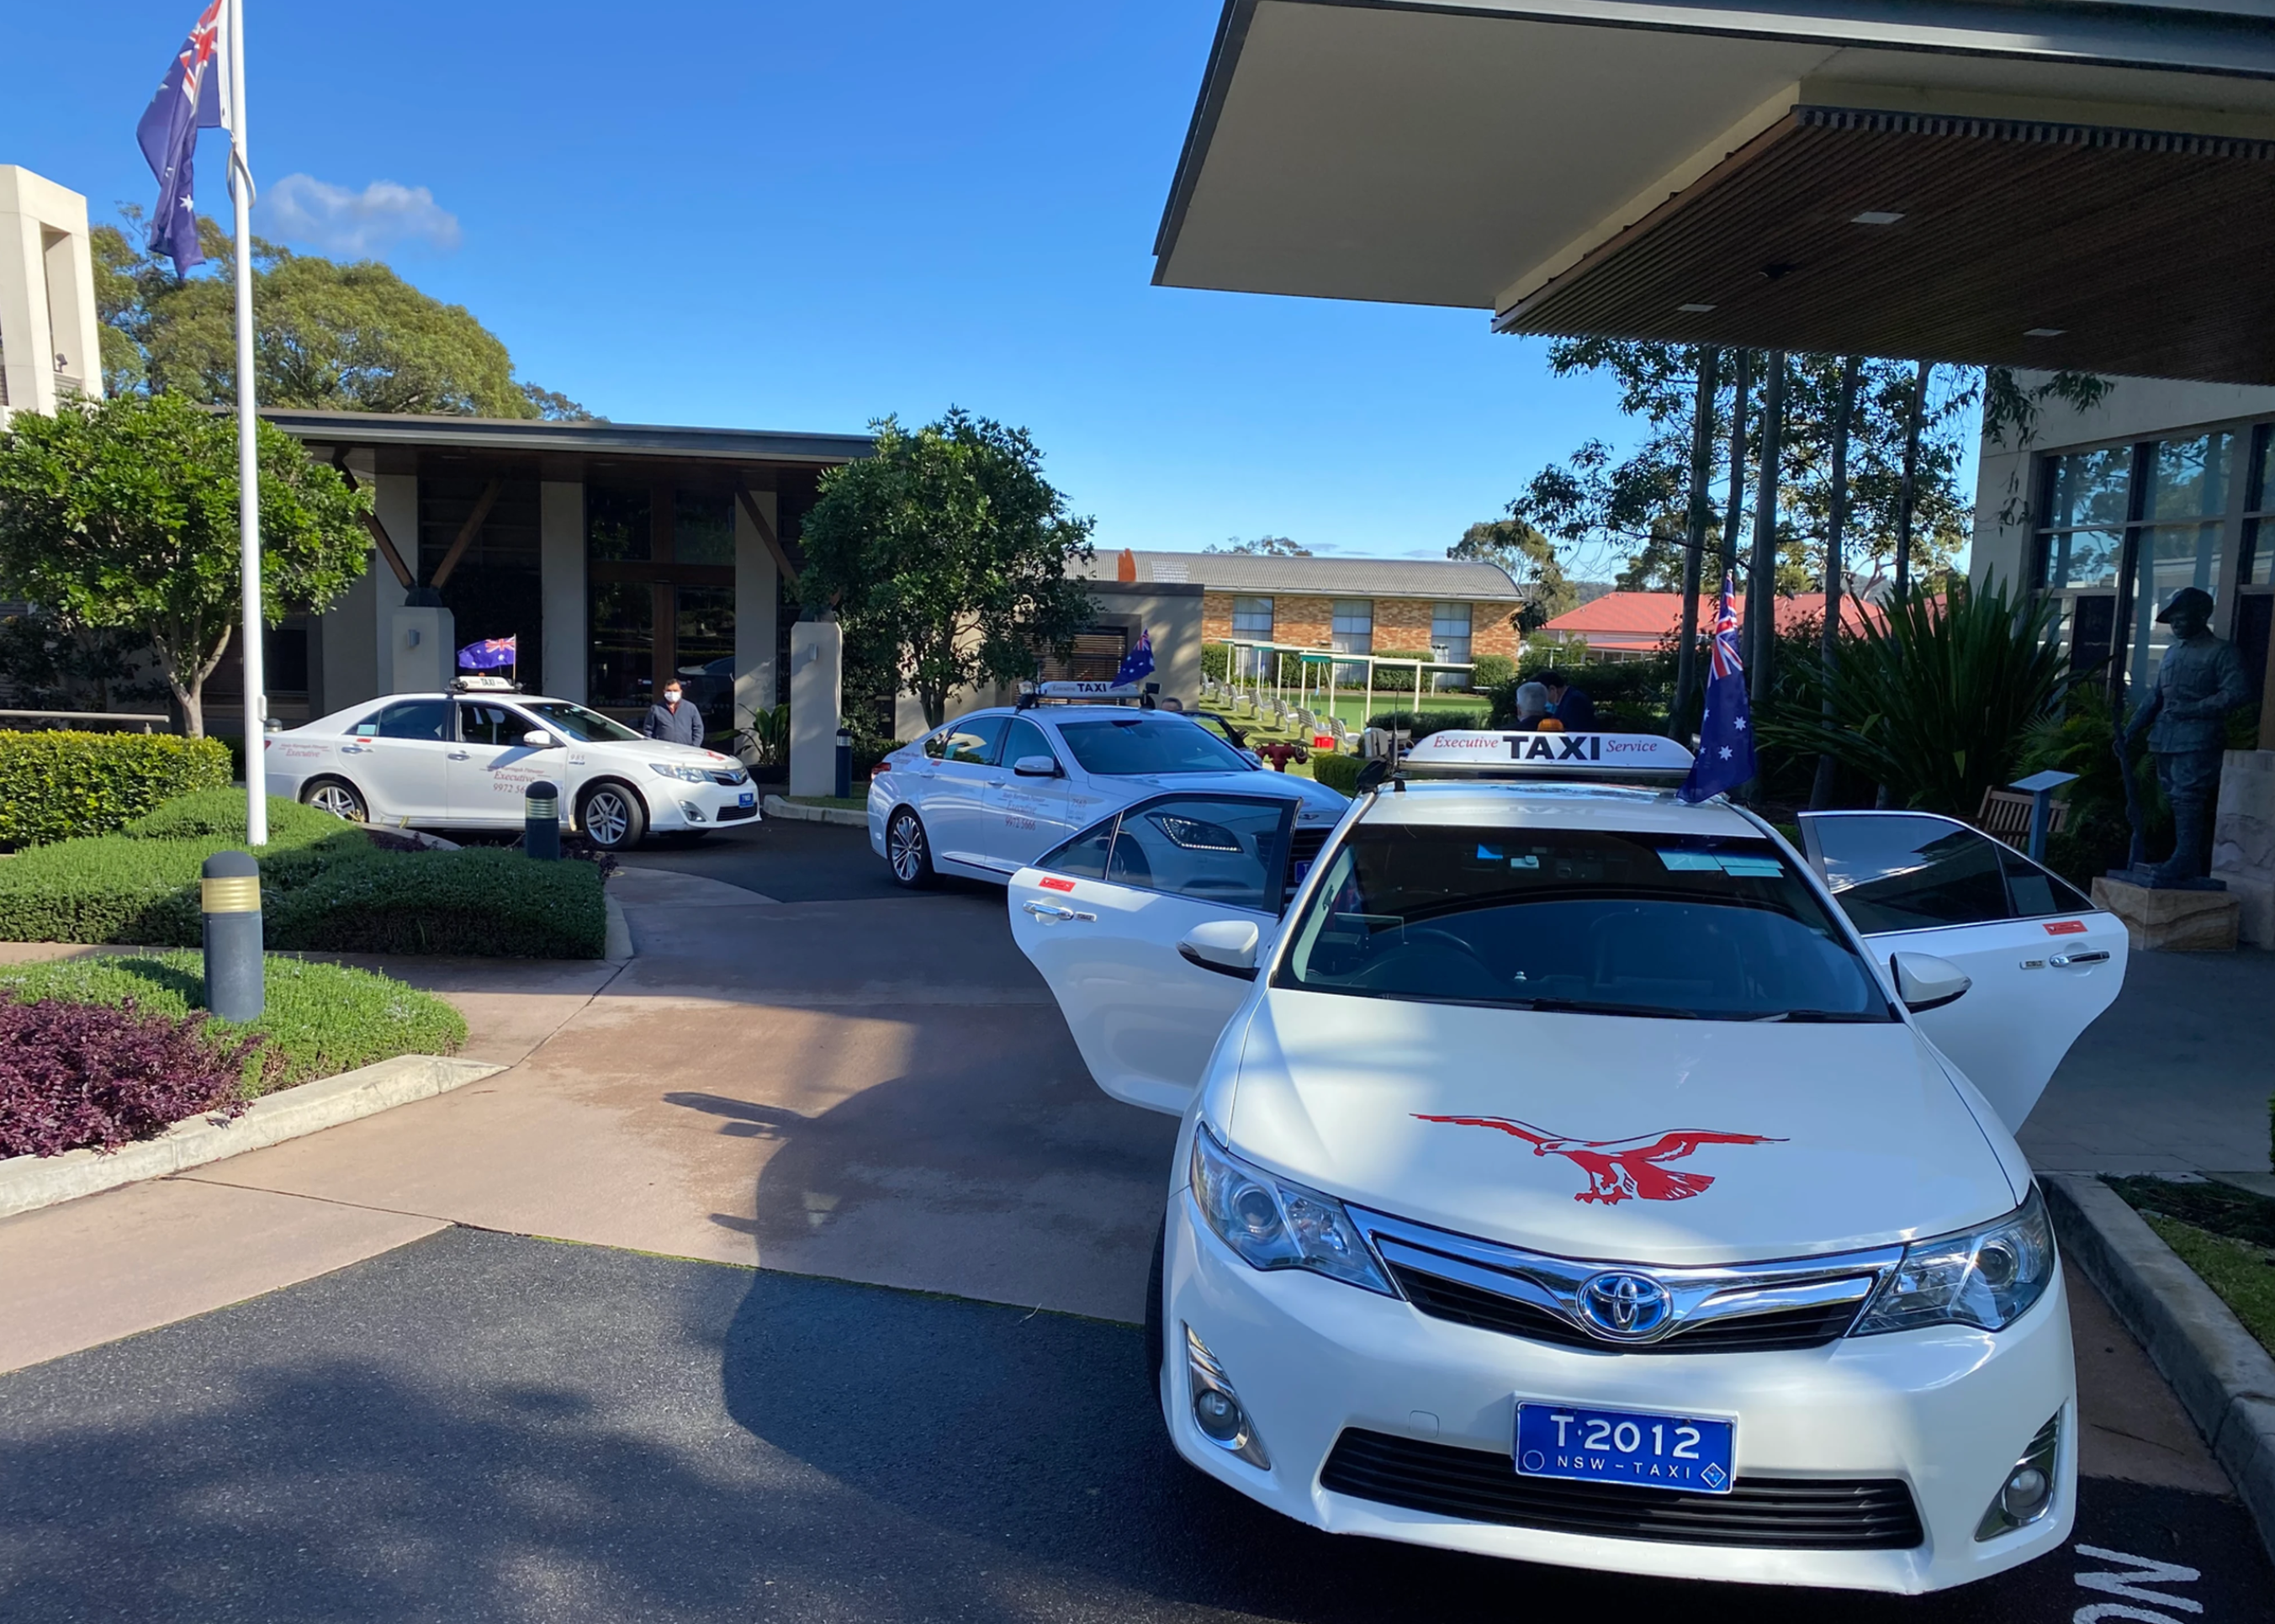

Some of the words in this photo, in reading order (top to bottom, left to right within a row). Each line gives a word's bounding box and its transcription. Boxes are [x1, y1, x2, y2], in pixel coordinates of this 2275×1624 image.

[480, 678, 495, 686] TAXI
[1077, 683, 1107, 692] TAXI
[1433, 735, 1499, 749] Executive
[1502, 735, 1600, 760] TAXI
[1606, 739, 1658, 754] Service
[494, 770, 535, 783] Executive
[493, 783, 514, 793] 9972
